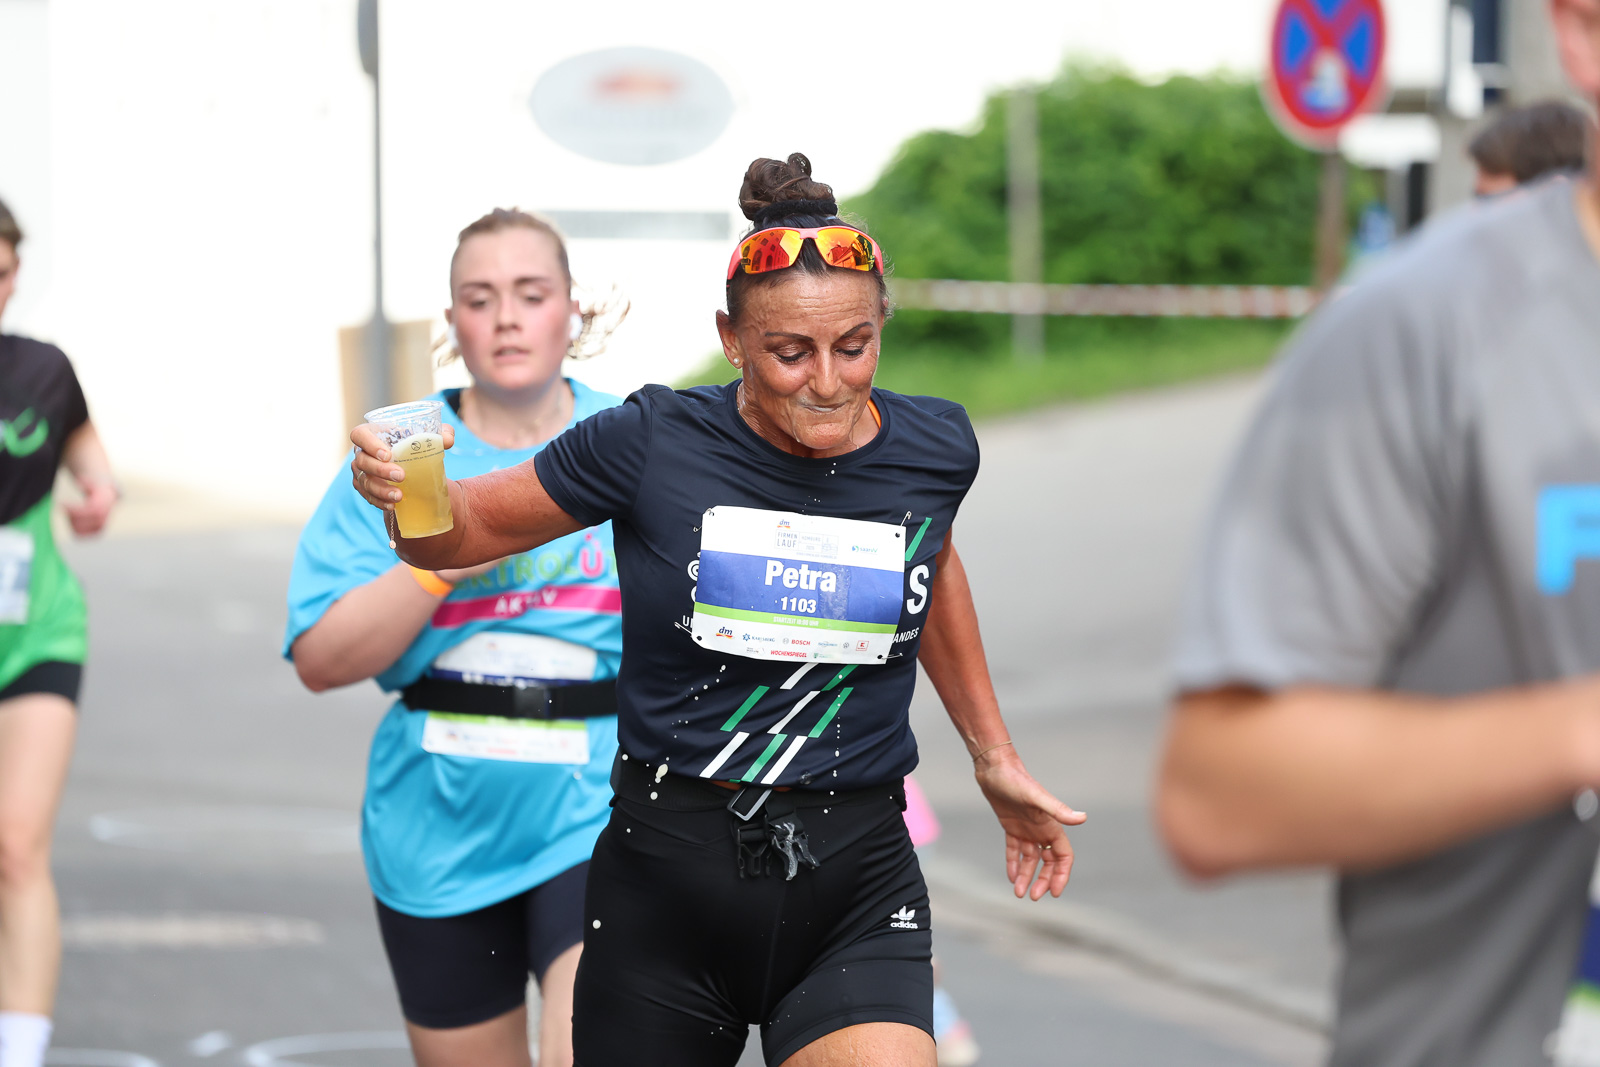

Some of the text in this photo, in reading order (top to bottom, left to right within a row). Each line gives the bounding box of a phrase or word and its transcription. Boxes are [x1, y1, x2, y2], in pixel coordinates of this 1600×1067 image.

[777, 531, 798, 539] FIRMEN
[776, 538, 797, 548] LAUF
[764, 559, 837, 593] Petra
[780, 596, 817, 614] 1103
[718, 626, 733, 635] dm
[893, 627, 920, 644] ANDES
[770, 649, 807, 658] WOCHENSPIEGEL
[890, 920, 918, 929] adidas
